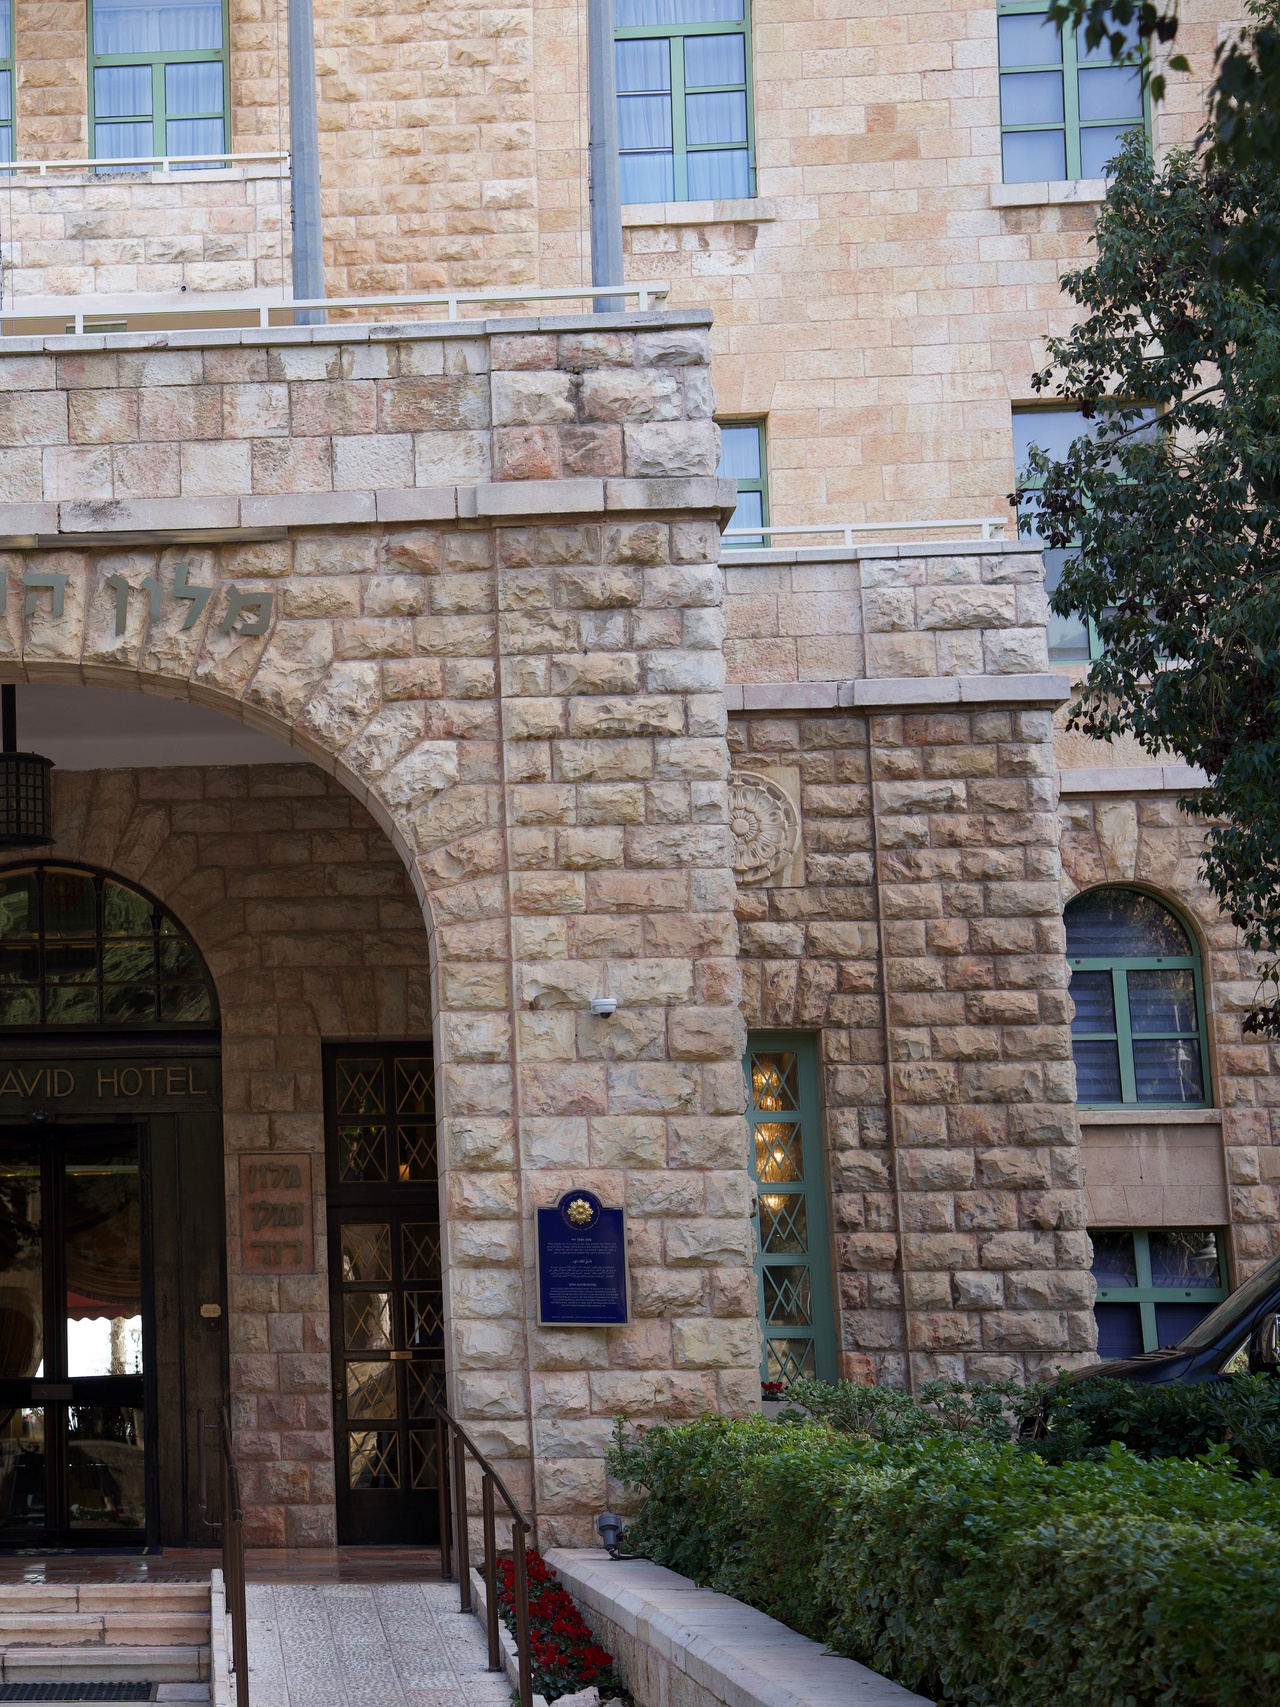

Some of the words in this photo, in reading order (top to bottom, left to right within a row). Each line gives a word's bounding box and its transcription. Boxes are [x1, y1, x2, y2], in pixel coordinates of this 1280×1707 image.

[107, 561, 275, 638] מלון
[96, 1066, 209, 1097] HOTEL
[248, 1162, 302, 1194] מלון
[248, 1201, 305, 1232] המלך
[250, 1240, 303, 1265] דוד
